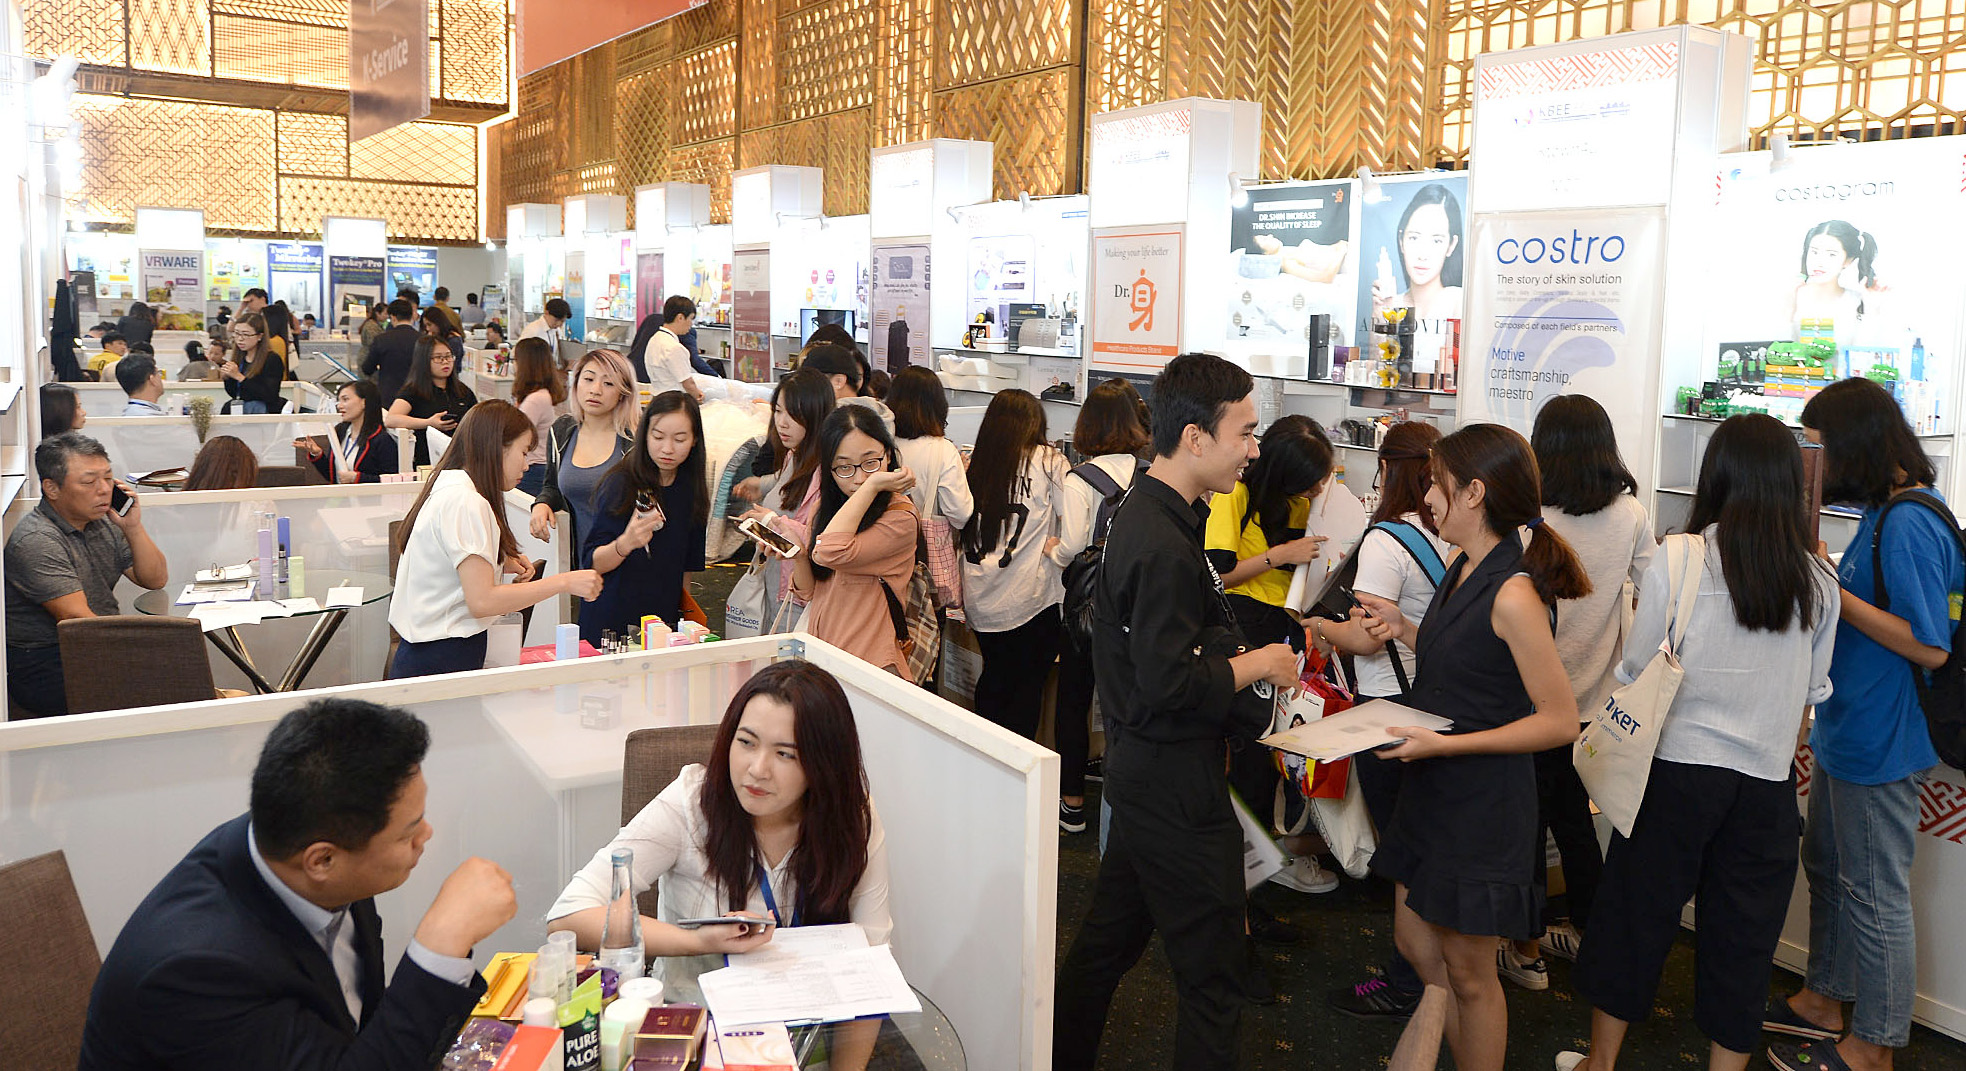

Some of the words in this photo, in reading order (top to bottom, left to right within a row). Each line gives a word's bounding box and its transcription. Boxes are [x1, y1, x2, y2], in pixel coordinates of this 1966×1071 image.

[362, 34, 409, 85] K-Service
[1775, 181, 1894, 201] costagram
[1285, 211, 1317, 220] INCREASE
[1252, 222, 1266, 230] THE
[1265, 221, 1295, 230] QUALITY
[1294, 220, 1302, 229] OF
[1301, 220, 1322, 229] SLEEP
[1105, 247, 1126, 261] Making
[1127, 249, 1141, 260] your
[1141, 245, 1151, 260] life
[1151, 245, 1169, 256] better
[1496, 228, 1625, 264] costro
[145, 255, 198, 268] VRWARE
[1497, 274, 1514, 284] The
[1516, 275, 1541, 286] story
[1542, 274, 1553, 284] of
[1555, 274, 1576, 284] skin
[1579, 273, 1622, 285] solution
[1114, 284, 1130, 298] Dr.
[1494, 321, 1530, 330] Composed
[1531, 322, 1540, 330] of
[1541, 322, 1558, 330] each
[1559, 323, 1582, 331] field's
[1583, 323, 1618, 332] partners
[1492, 347, 1526, 361] Motive
[1490, 366, 1572, 386] craftsmanship,
[1489, 387, 1534, 401] maestro
[566, 1029, 598, 1053] PURE
[566, 1044, 599, 1068] ALOE
